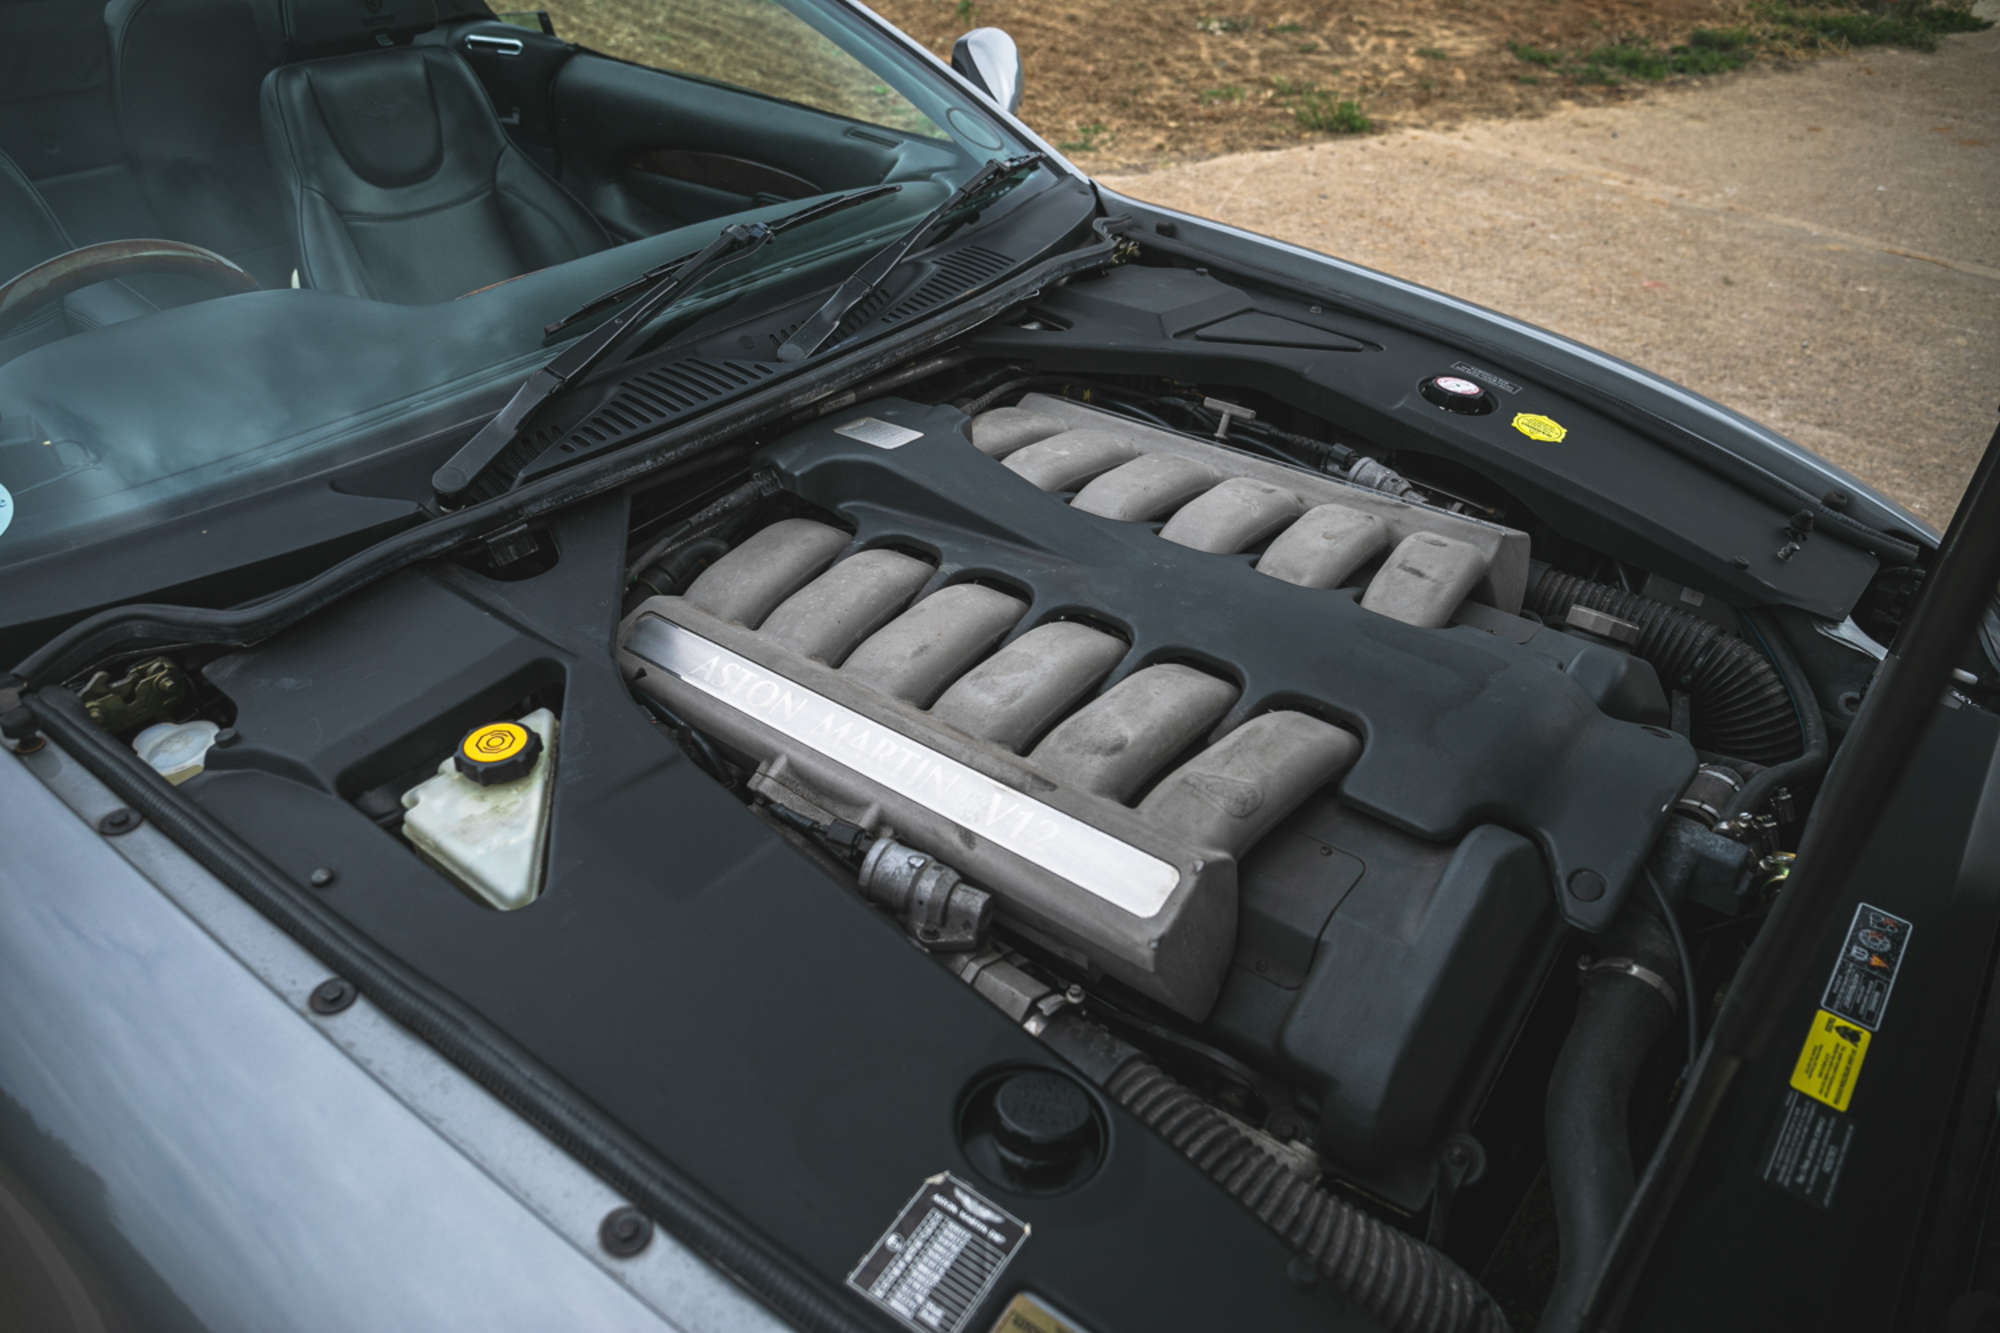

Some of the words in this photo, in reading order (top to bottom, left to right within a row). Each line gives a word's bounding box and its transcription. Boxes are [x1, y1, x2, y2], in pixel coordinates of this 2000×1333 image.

[691, 655, 807, 721] ASTON
[808, 710, 961, 801] MARTIN
[984, 792, 1061, 850] V12
